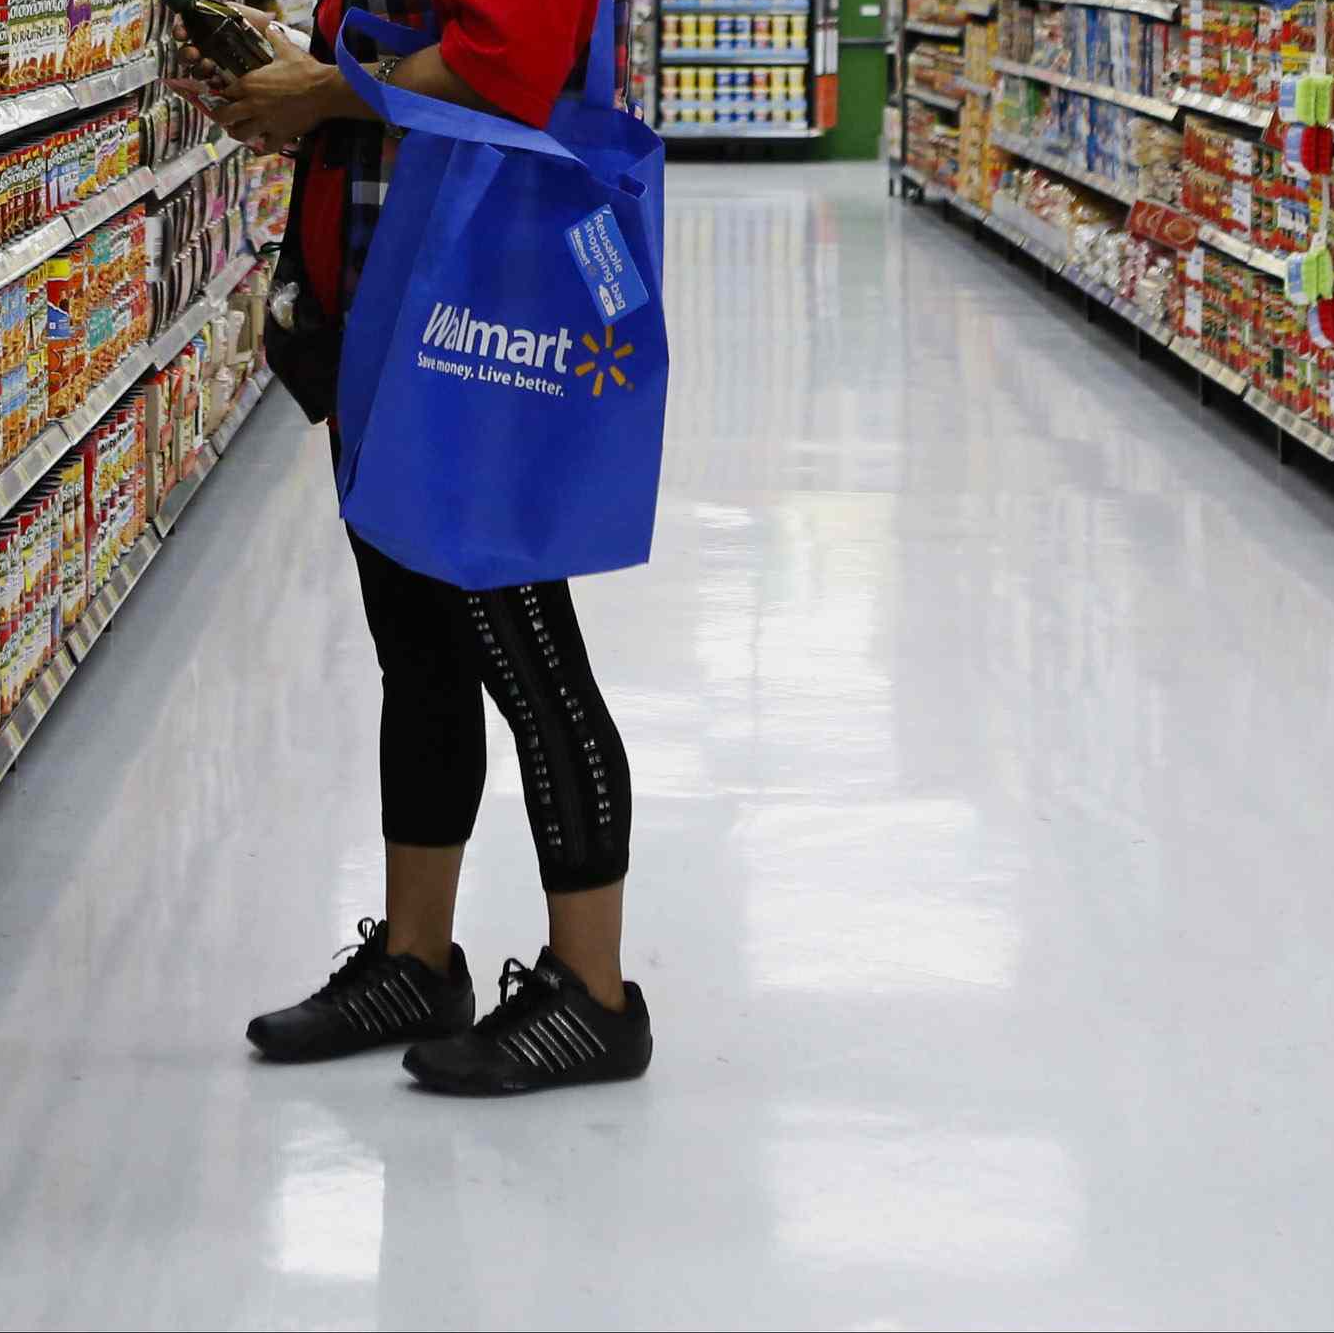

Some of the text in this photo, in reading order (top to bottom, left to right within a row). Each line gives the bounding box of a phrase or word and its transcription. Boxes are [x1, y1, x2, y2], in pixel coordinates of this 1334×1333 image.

[584, 220, 627, 311] shopping bag
[593, 213, 624, 274] Reusable
[421, 301, 574, 374] Walmart
[417, 351, 565, 398] Save money. Live better.
